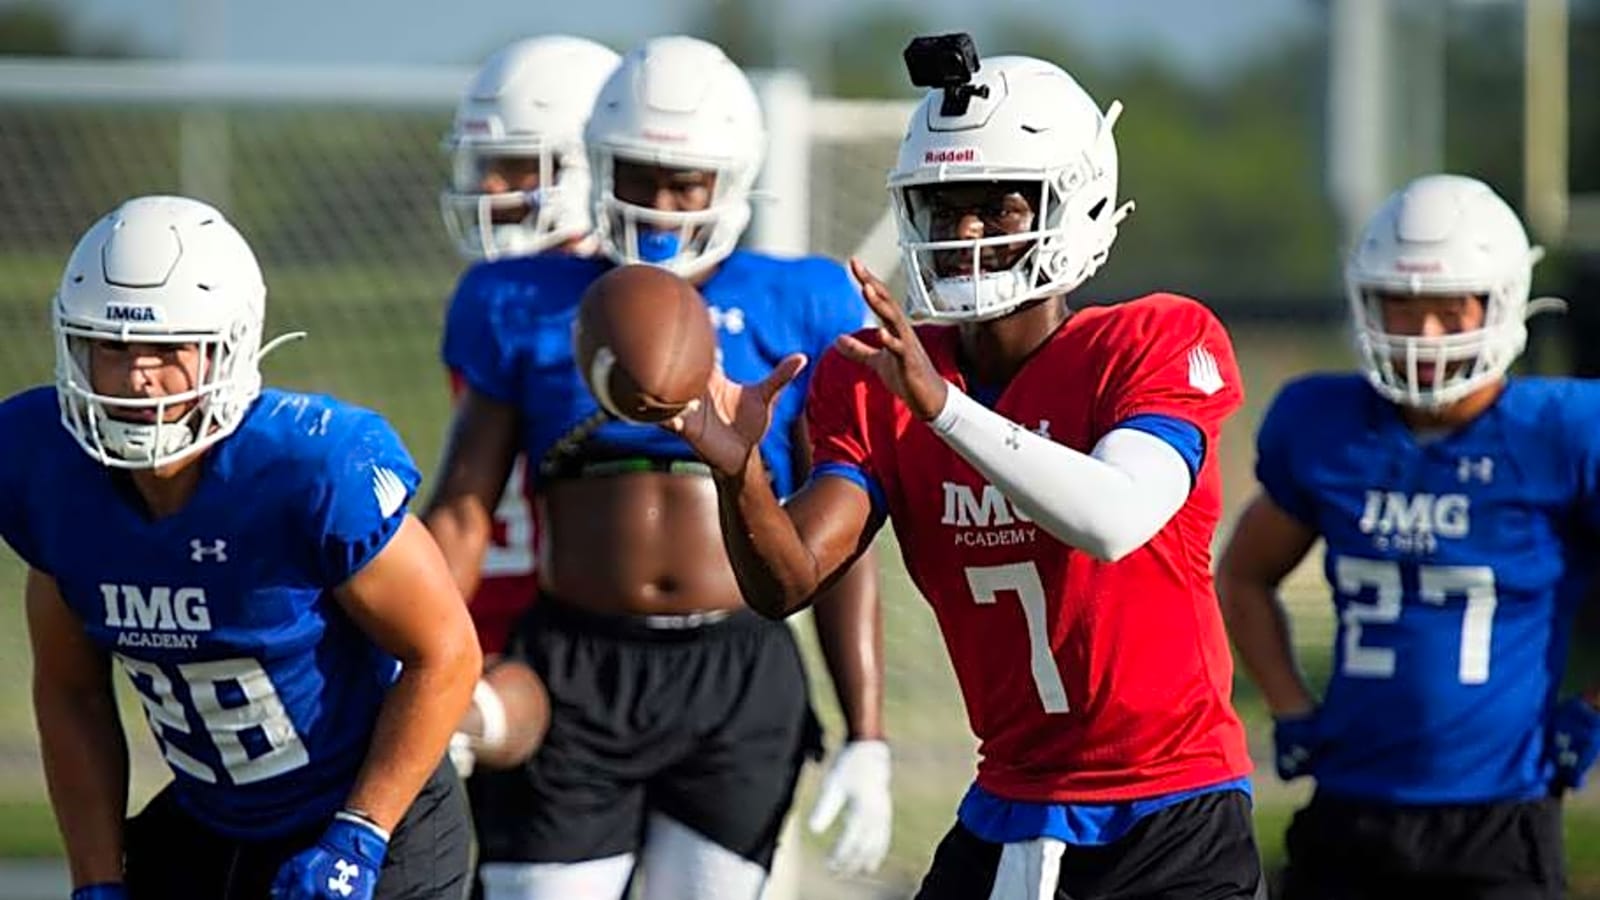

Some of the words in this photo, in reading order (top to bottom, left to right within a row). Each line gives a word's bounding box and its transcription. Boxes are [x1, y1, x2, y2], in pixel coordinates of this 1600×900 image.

[925, 149, 974, 164] Riddell
[106, 305, 155, 321] IMGA
[954, 528, 1037, 547] ACADEMY
[1360, 489, 1470, 539] IMG
[99, 583, 212, 631] IMG
[1335, 555, 1497, 684] 27
[117, 632, 198, 649] ACADEMY
[964, 561, 1070, 714] 7
[112, 651, 310, 786] 28
